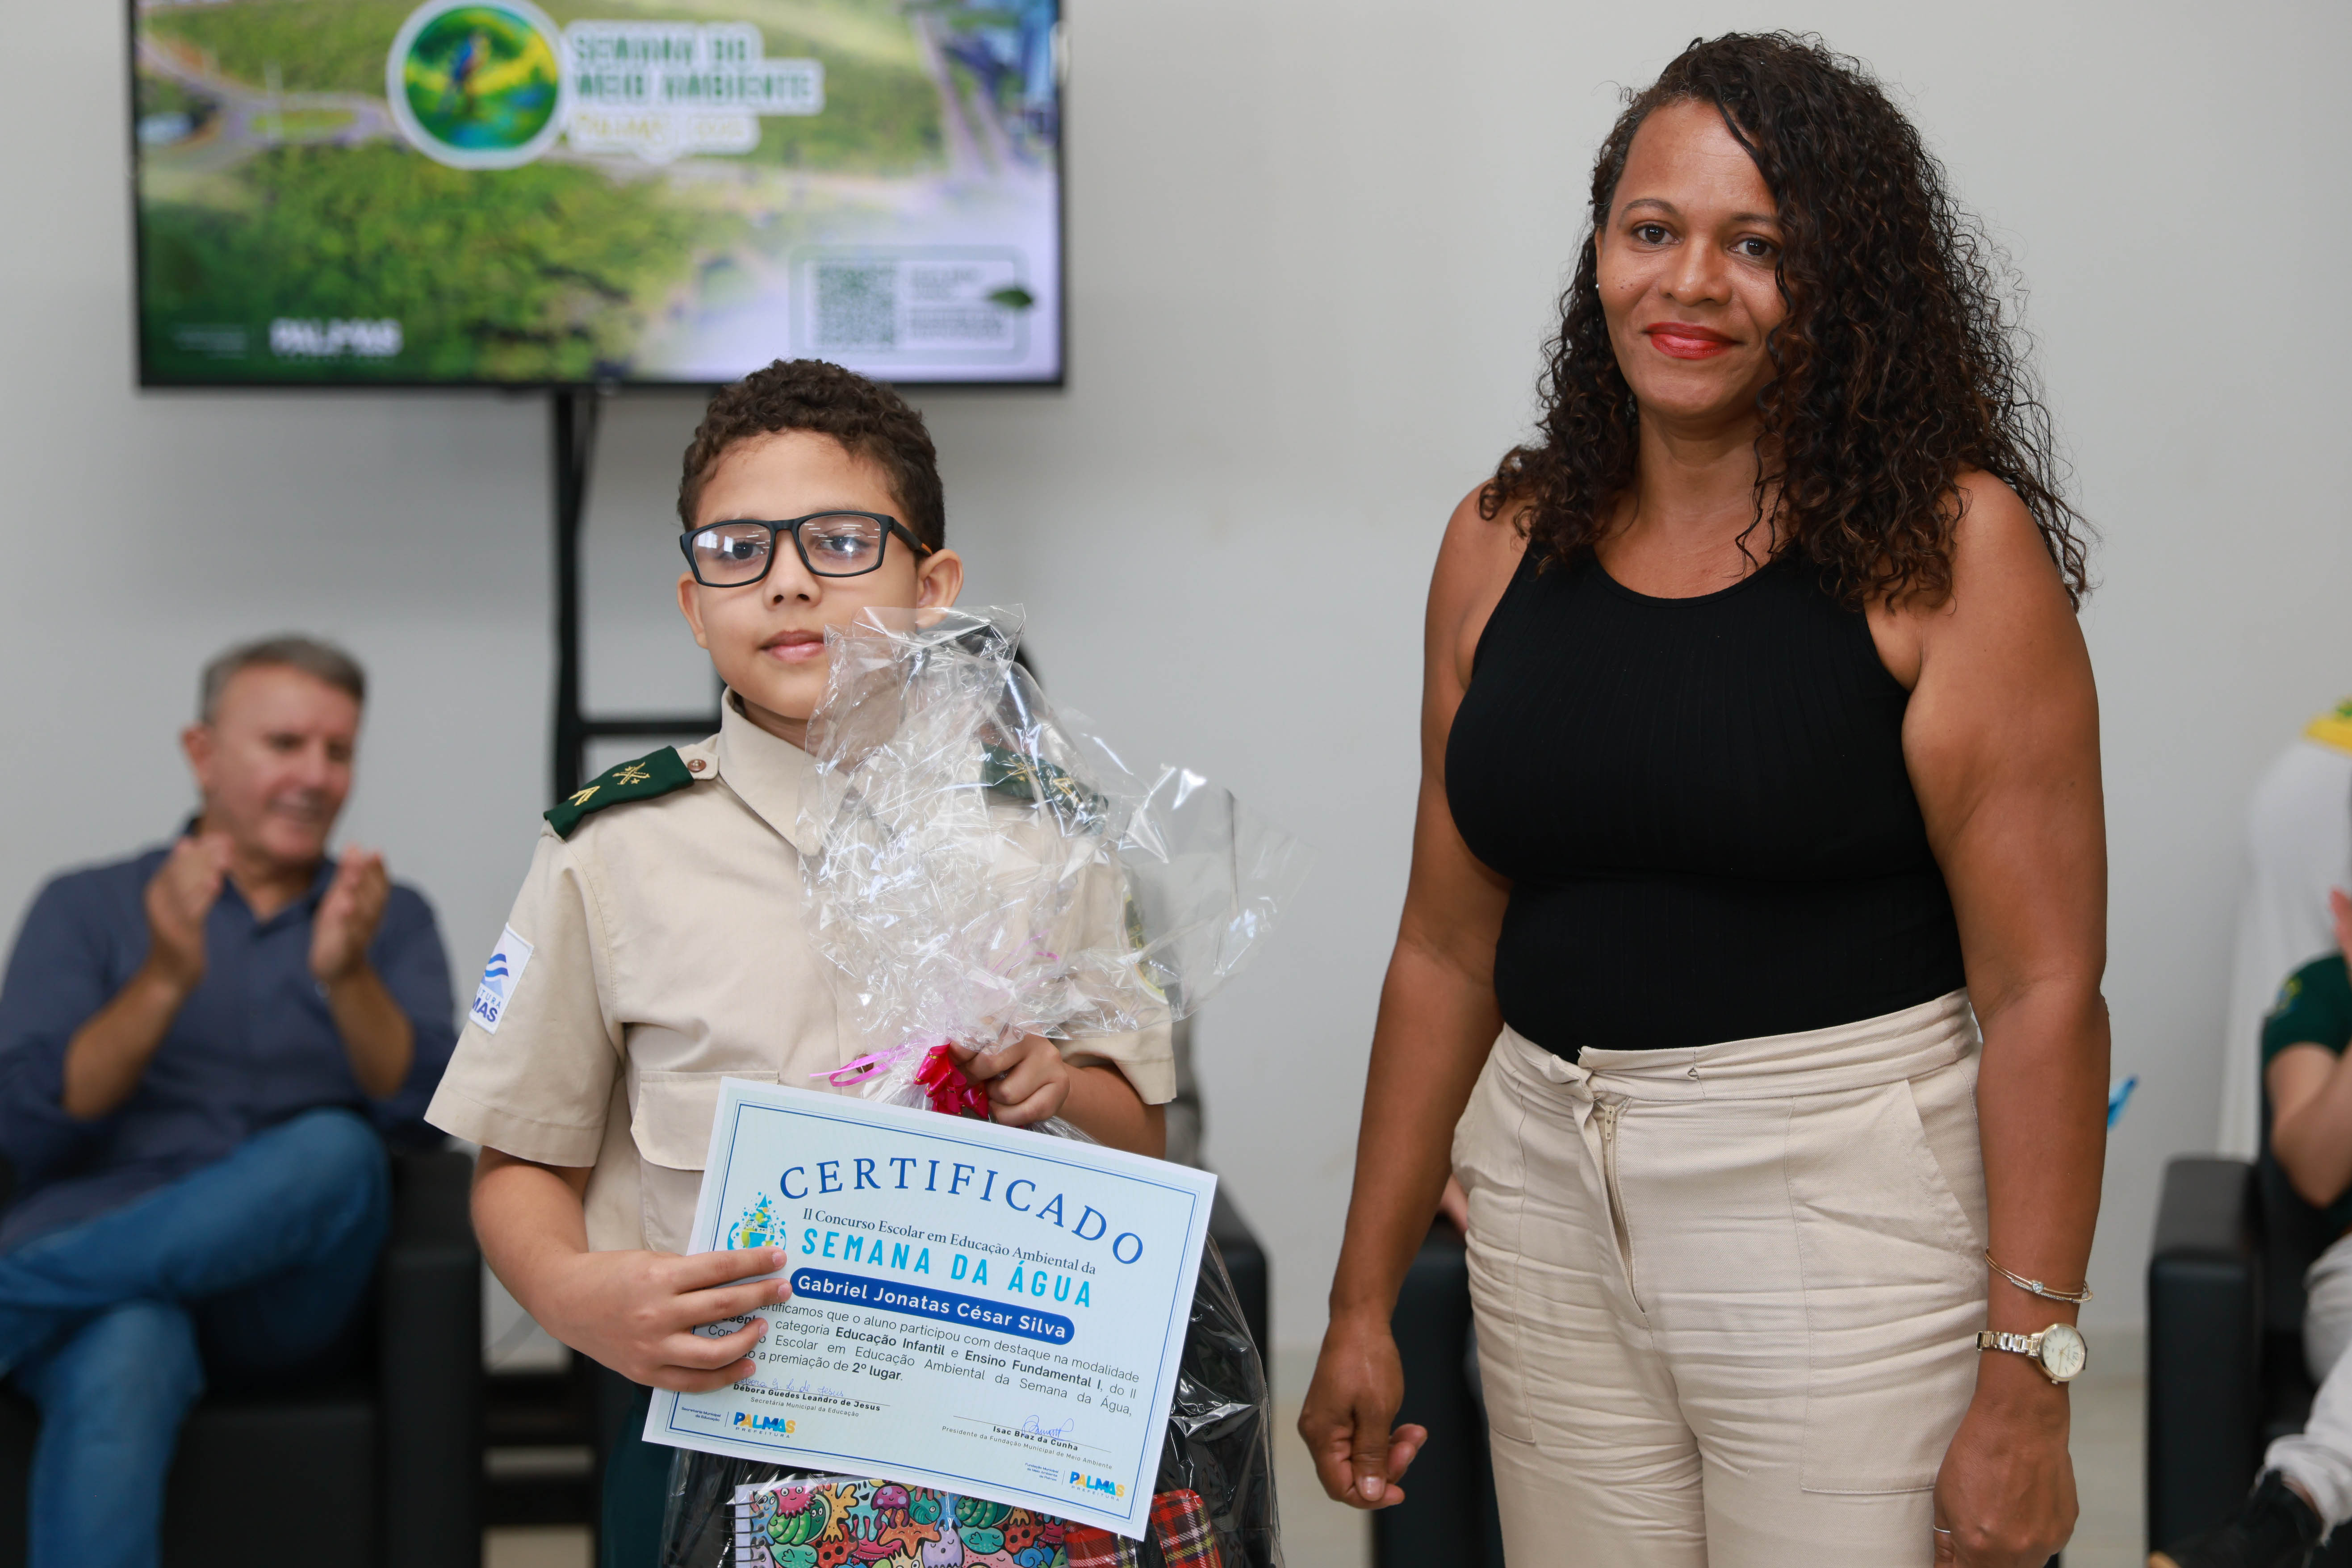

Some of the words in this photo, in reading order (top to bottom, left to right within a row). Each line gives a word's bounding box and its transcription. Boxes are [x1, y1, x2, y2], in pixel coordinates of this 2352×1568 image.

[780, 1157, 1143, 1265] CERTIFICADO
[803, 1208, 812, 1220] II
[816, 1211, 875, 1229] Concurso
[879, 1221, 925, 1238] Escolar
[928, 1233, 946, 1243] em
[950, 1234, 1009, 1255] Educação
[1013, 1247, 1079, 1270] Ambiental
[1082, 1262, 1095, 1274] da
[802, 1229, 929, 1274] SEMANA
[951, 1254, 988, 1285] DA
[1008, 1260, 1090, 1307] ÁGUA
[799, 1276, 866, 1298] Gabriel
[874, 1288, 949, 1313] Jonatas
[958, 1303, 1012, 1325] César
[1019, 1316, 1065, 1338] Silva
[754, 1301, 823, 1318] ertificamos
[827, 1312, 849, 1322] que
[864, 1316, 896, 1329] aluno
[900, 1324, 960, 1341] participou
[964, 1336, 990, 1347] com
[995, 1341, 1050, 1360] destaque
[1055, 1355, 1067, 1365] na
[1072, 1359, 1138, 1382] modalidade
[769, 1354, 829, 1369] premiação
[834, 1360, 848, 1371] de
[852, 1363, 866, 1373] 2º
[870, 1365, 902, 1380] lugar.
[776, 1320, 829, 1335] categoria
[836, 1327, 896, 1346] Educação
[903, 1338, 944, 1355] Infantil
[965, 1350, 1006, 1367] Ensino
[1013, 1360, 1091, 1387] Fundamental
[1097, 1380, 1102, 1392] I,
[1110, 1384, 1124, 1395] do
[1130, 1388, 1136, 1399] II
[776, 1335, 818, 1350] Escolar
[828, 1345, 845, 1354] em
[856, 1346, 914, 1365] Educação
[925, 1359, 984, 1380] Ambiental
[995, 1374, 1009, 1384] da
[1020, 1379, 1067, 1398] Semana
[1077, 1392, 1091, 1404] da
[1101, 1396, 1131, 1416] Água,
[733, 1384, 765, 1394] Débora
[768, 1389, 799, 1399] Guedes
[803, 1394, 837, 1404] Leandro
[854, 1401, 880, 1411] Jesus
[751, 1397, 783, 1406] Secretária
[828, 1408, 858, 1416] Educação
[733, 1412, 796, 1434] PALMAS
[736, 1426, 790, 1438] PREFEITURA
[993, 1426, 1011, 1435] Isac
[1014, 1430, 1034, 1441] Braz
[1051, 1439, 1077, 1451] Cunha
[942, 1426, 977, 1437] Presidente
[990, 1436, 1021, 1446] Fundação
[1024, 1443, 1054, 1454] Municipal
[1083, 1458, 1112, 1469] Ambiente
[1069, 1471, 1125, 1497] PALMAS
[1071, 1485, 1120, 1501] PREFEITURA
